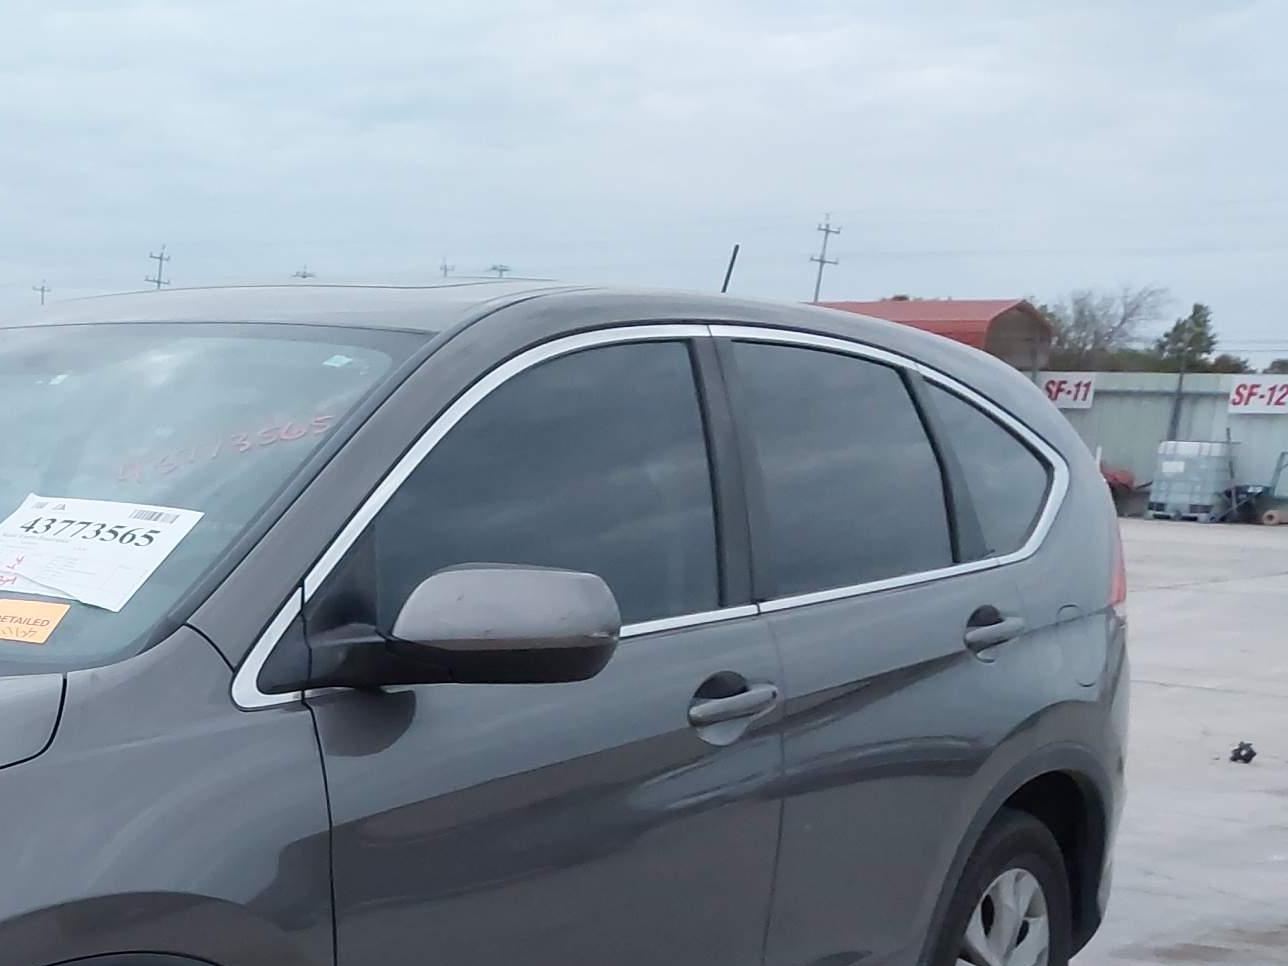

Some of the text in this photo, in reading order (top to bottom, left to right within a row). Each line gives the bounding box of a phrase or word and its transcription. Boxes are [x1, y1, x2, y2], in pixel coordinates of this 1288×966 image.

[1044, 380, 1092, 402] SF-11
[1231, 383, 1288, 406] SF-12
[20, 516, 160, 547] 43773565
